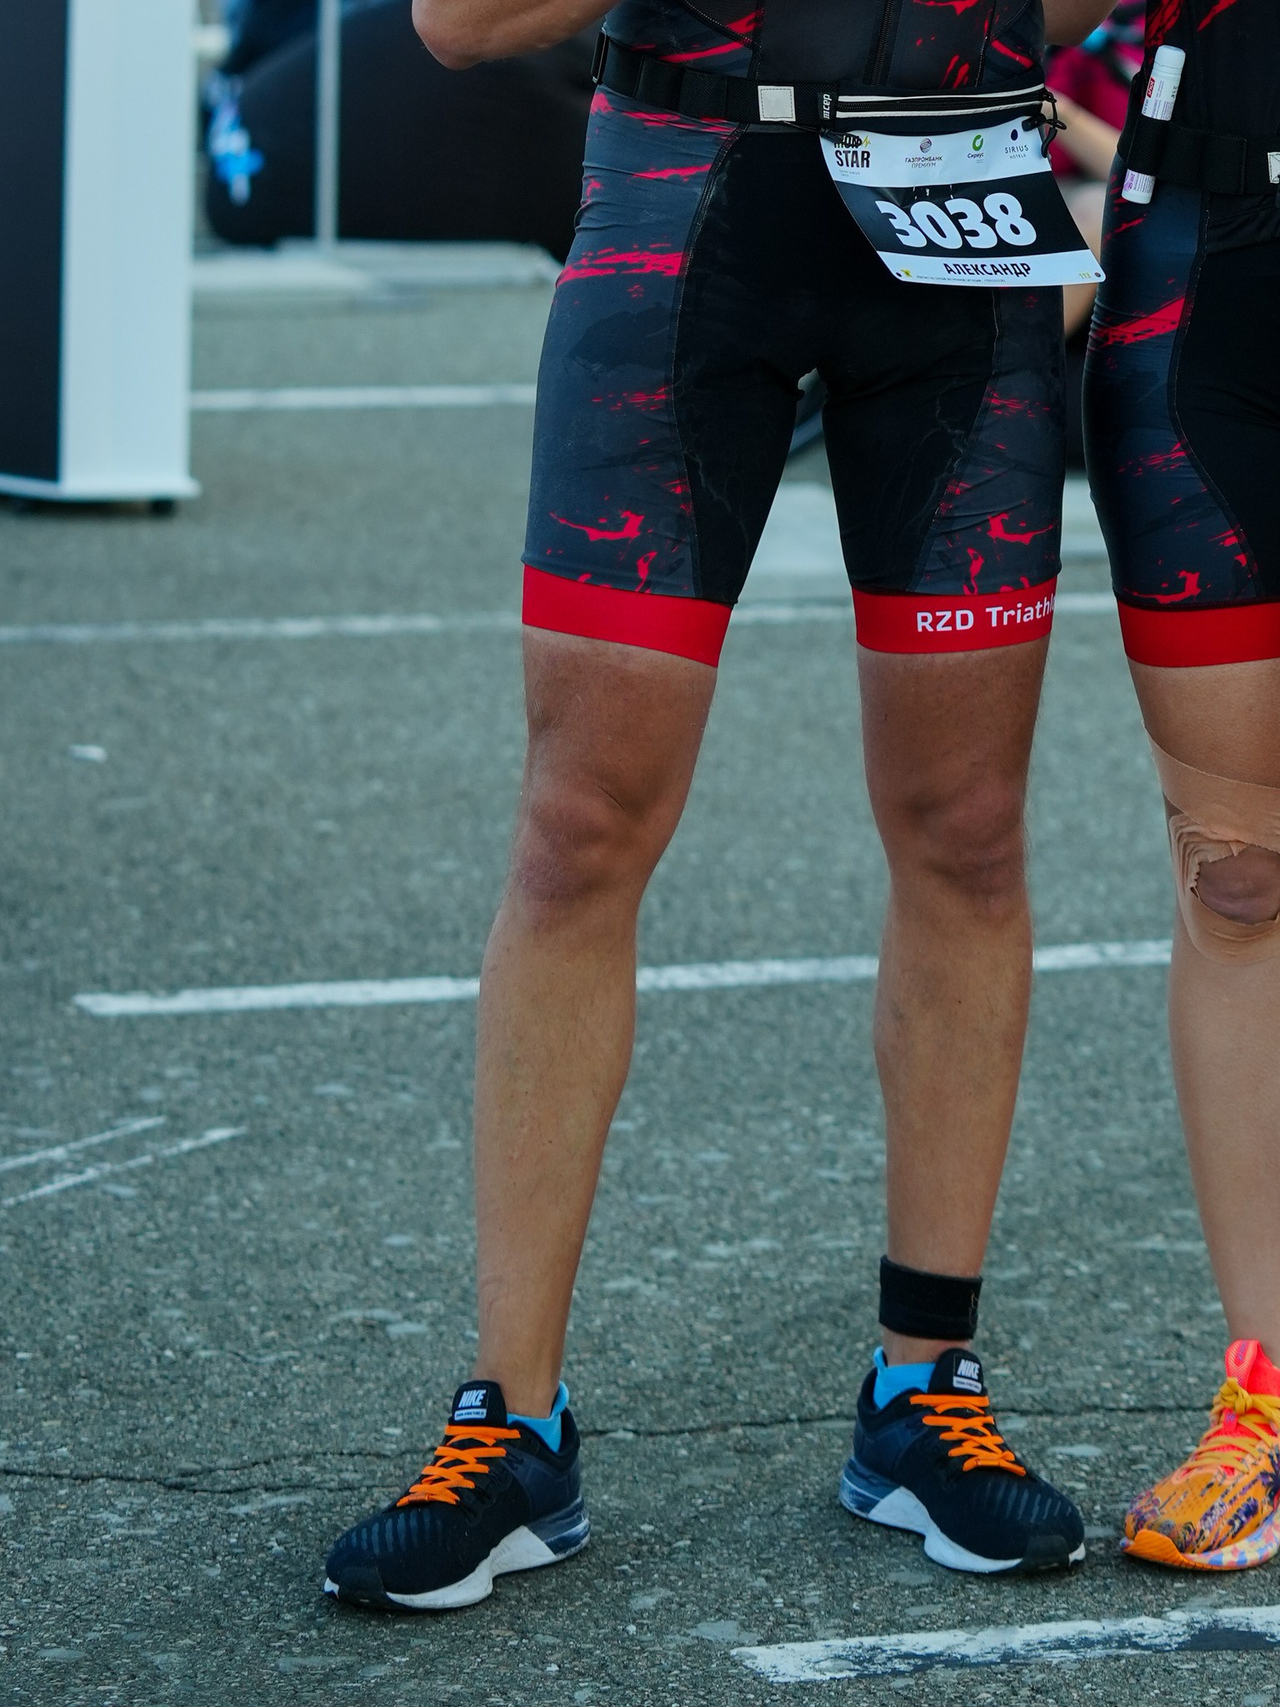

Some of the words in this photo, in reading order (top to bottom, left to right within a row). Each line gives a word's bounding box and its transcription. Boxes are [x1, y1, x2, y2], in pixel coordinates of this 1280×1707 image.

[823, 94, 832, 110] cep
[1005, 145, 1029, 154] SIRIUS
[835, 150, 870, 168] STAR
[905, 155, 943, 163] ГАЗПРОМБАНК
[875, 192, 1037, 249] 3038
[943, 262, 1032, 277] АЛЕКСАНДР
[1078, 272, 1091, 280] 113
[916, 609, 974, 632] RZD
[957, 1359, 980, 1380] NIKE
[458, 1390, 487, 1408] NIKE
